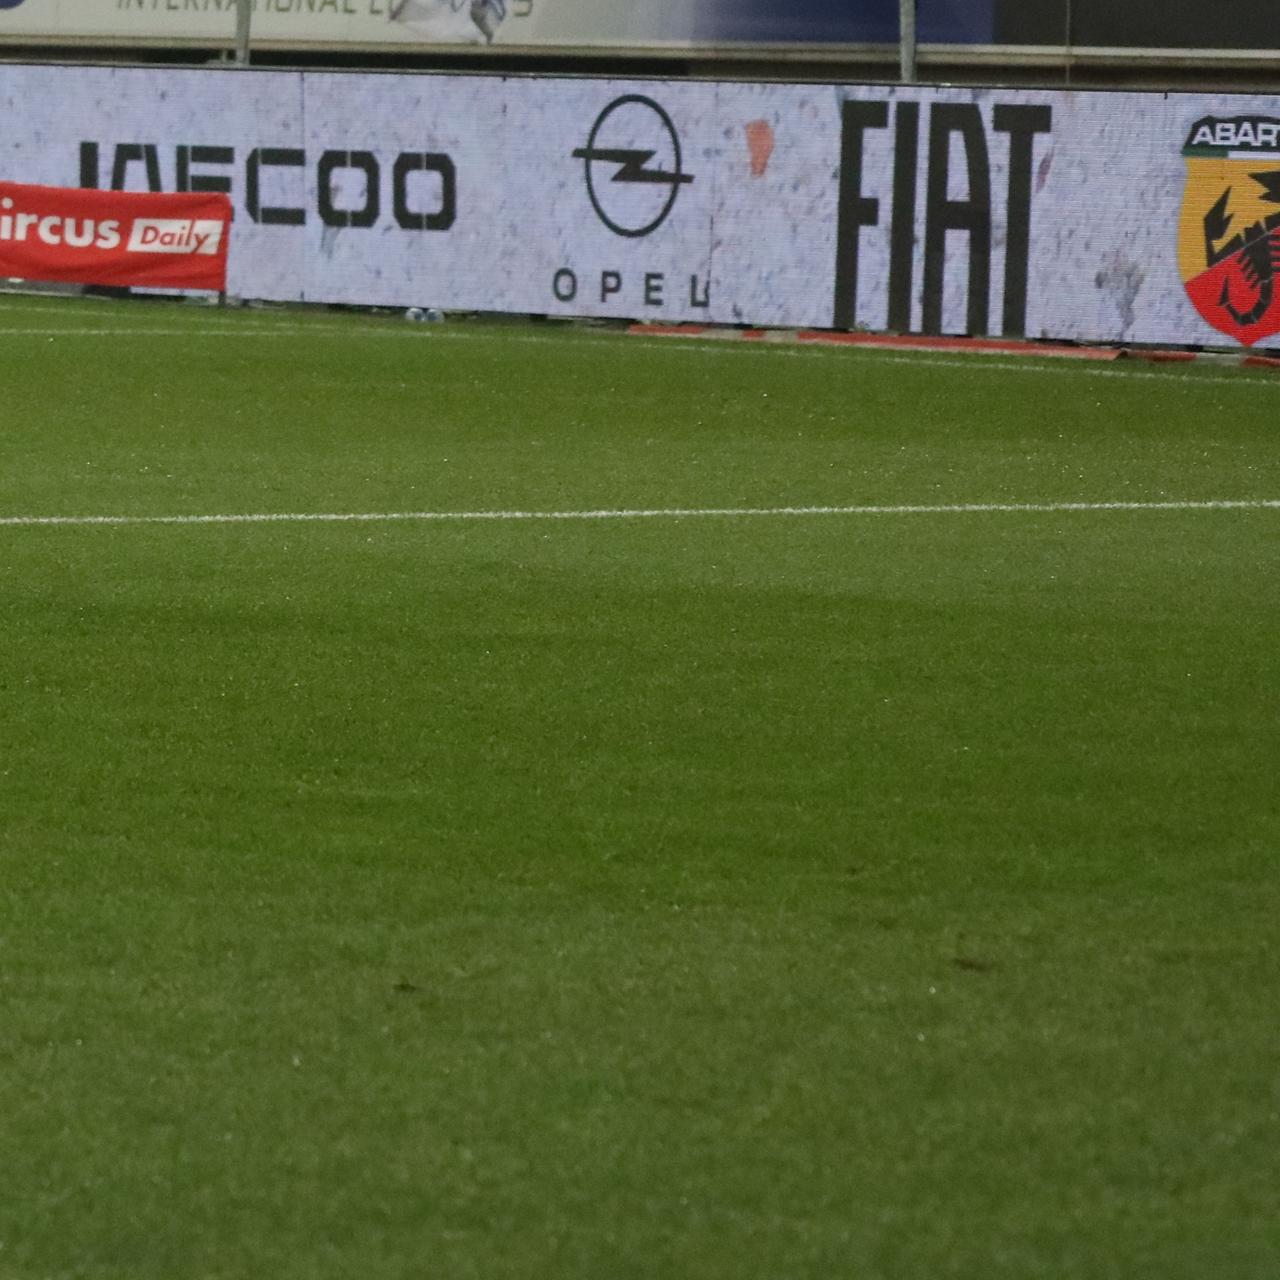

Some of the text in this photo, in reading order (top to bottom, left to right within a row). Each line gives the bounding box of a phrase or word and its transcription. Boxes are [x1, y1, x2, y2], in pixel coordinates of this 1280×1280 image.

[1192, 121, 1280, 147] ABAR
[834, 100, 1053, 338] FIAT
[139, 221, 210, 254] Daily
[553, 268, 709, 308] OPEL
